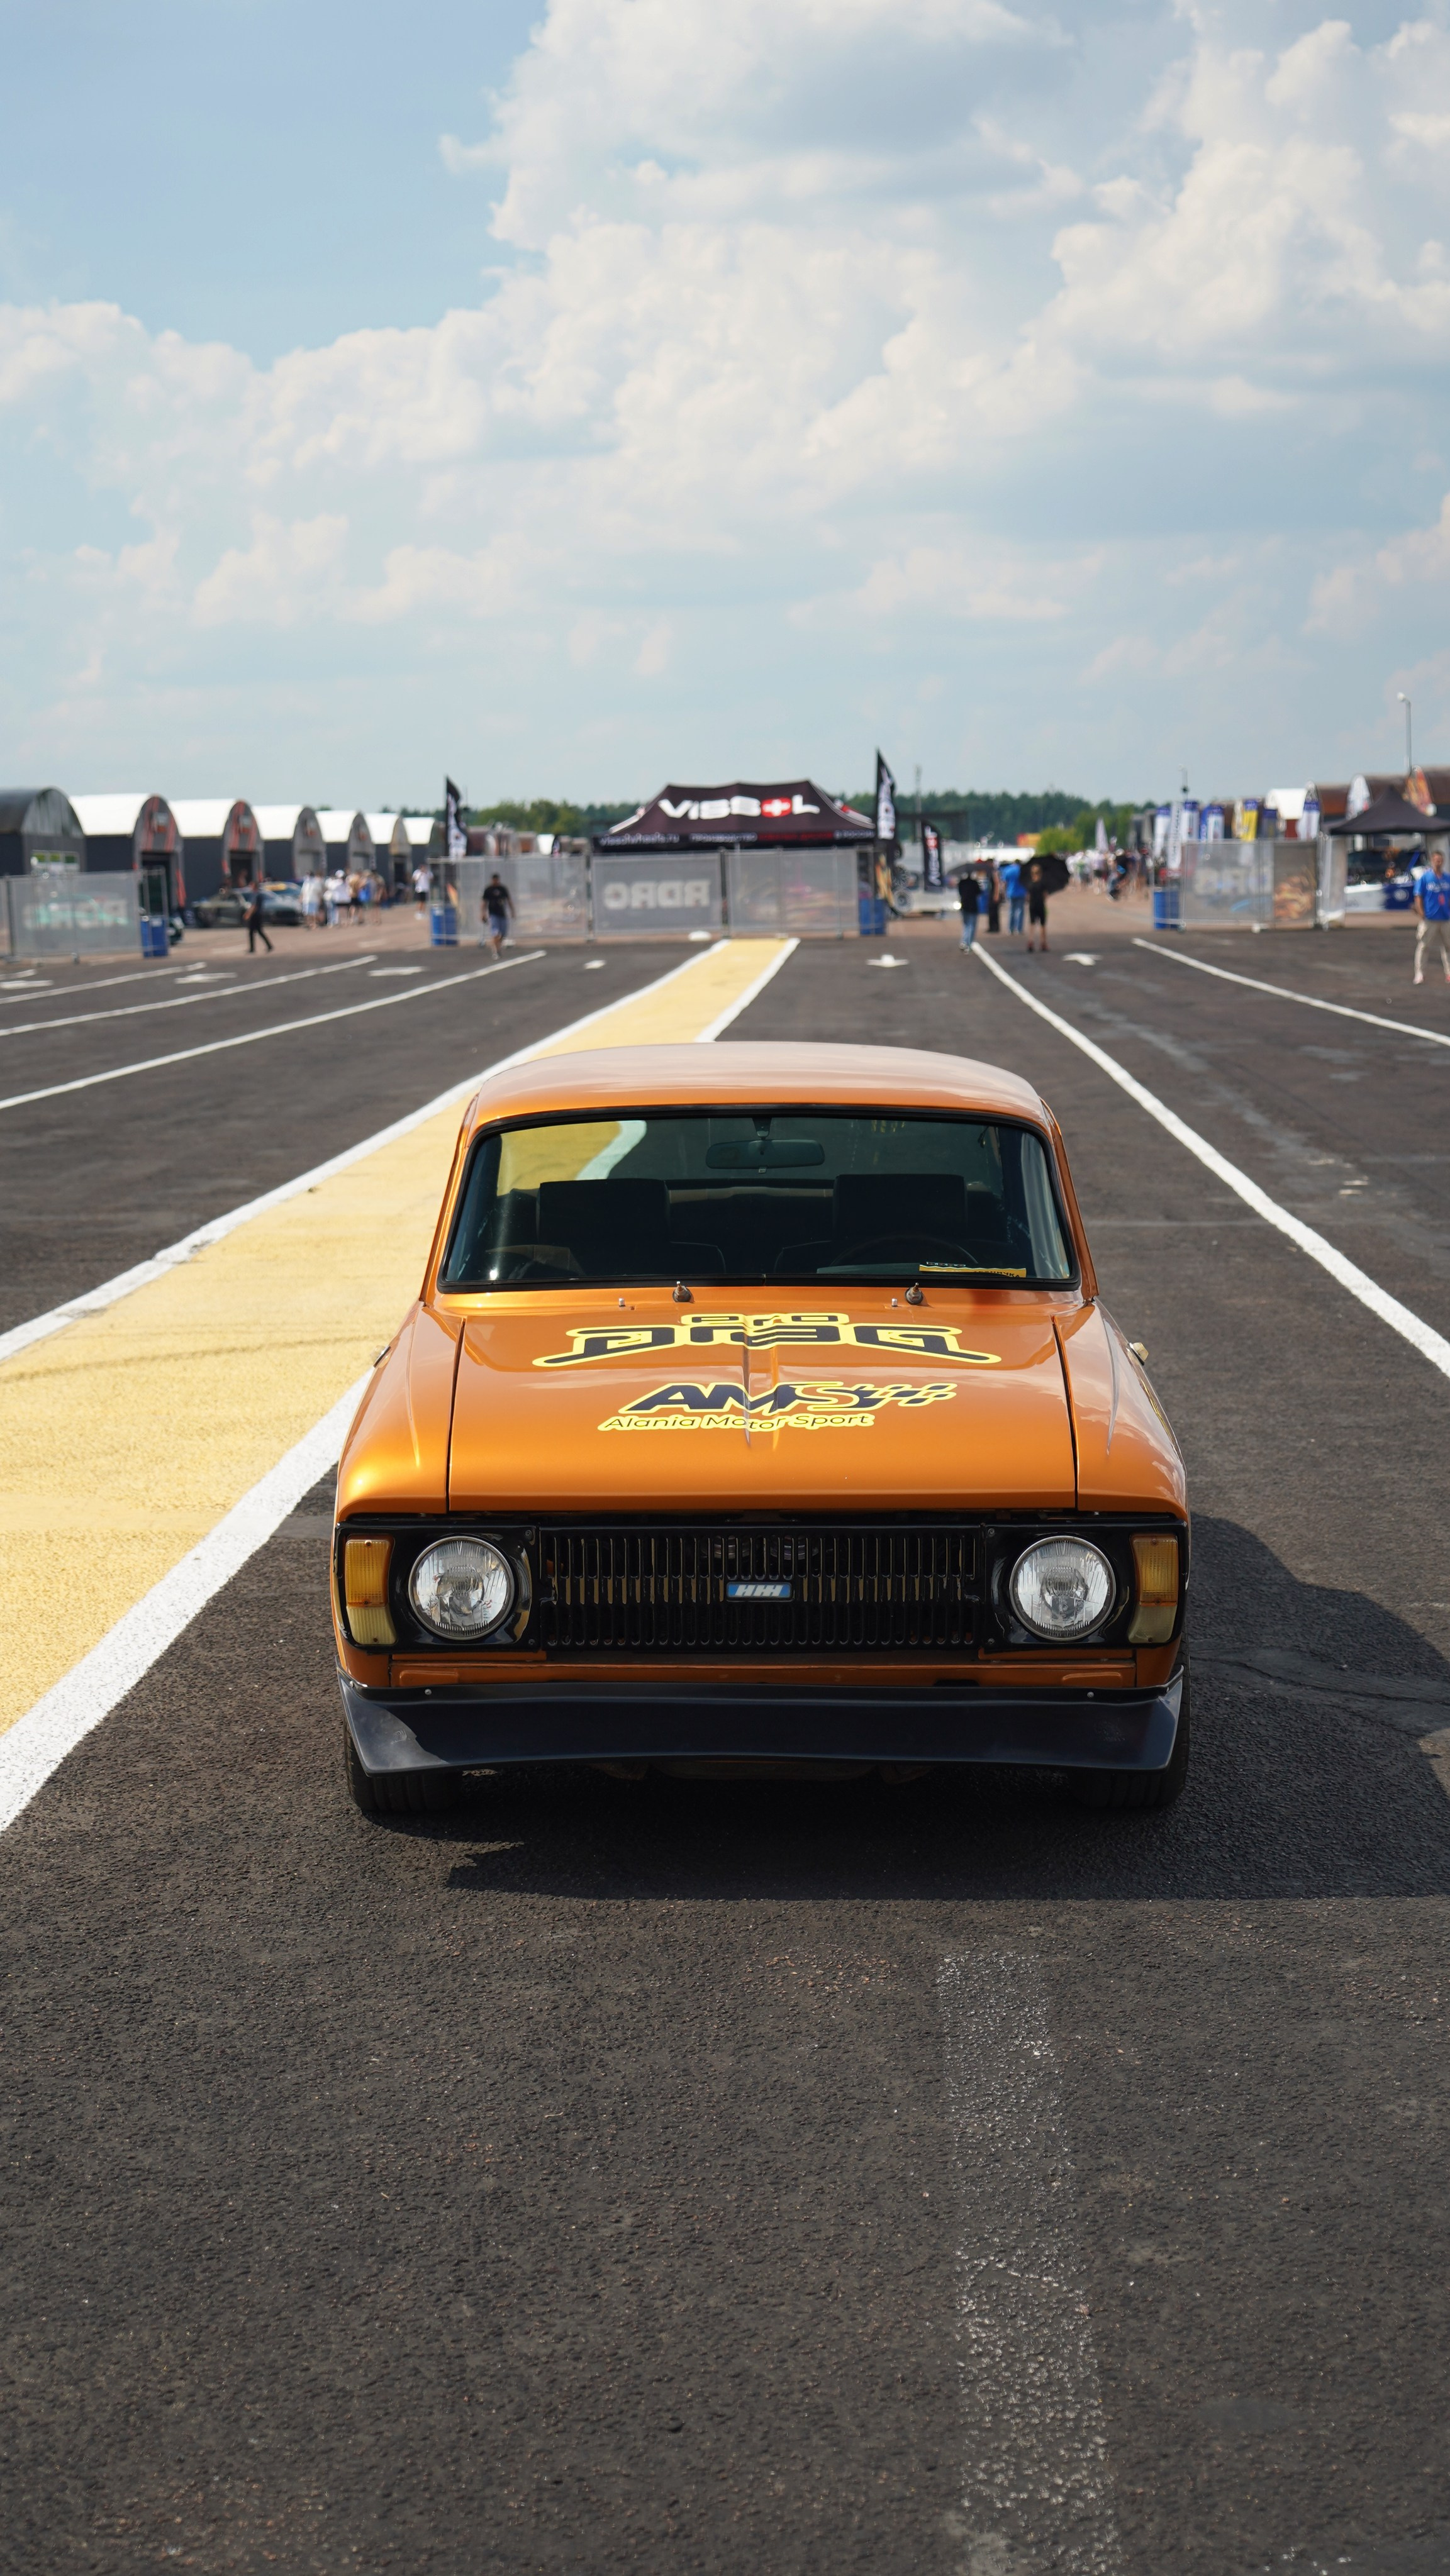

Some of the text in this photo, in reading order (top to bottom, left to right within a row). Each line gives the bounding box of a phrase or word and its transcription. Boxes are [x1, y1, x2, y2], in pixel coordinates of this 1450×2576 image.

[619, 1382, 888, 1416] AMS
[605, 1415, 869, 1430] Alania Motor Sport
